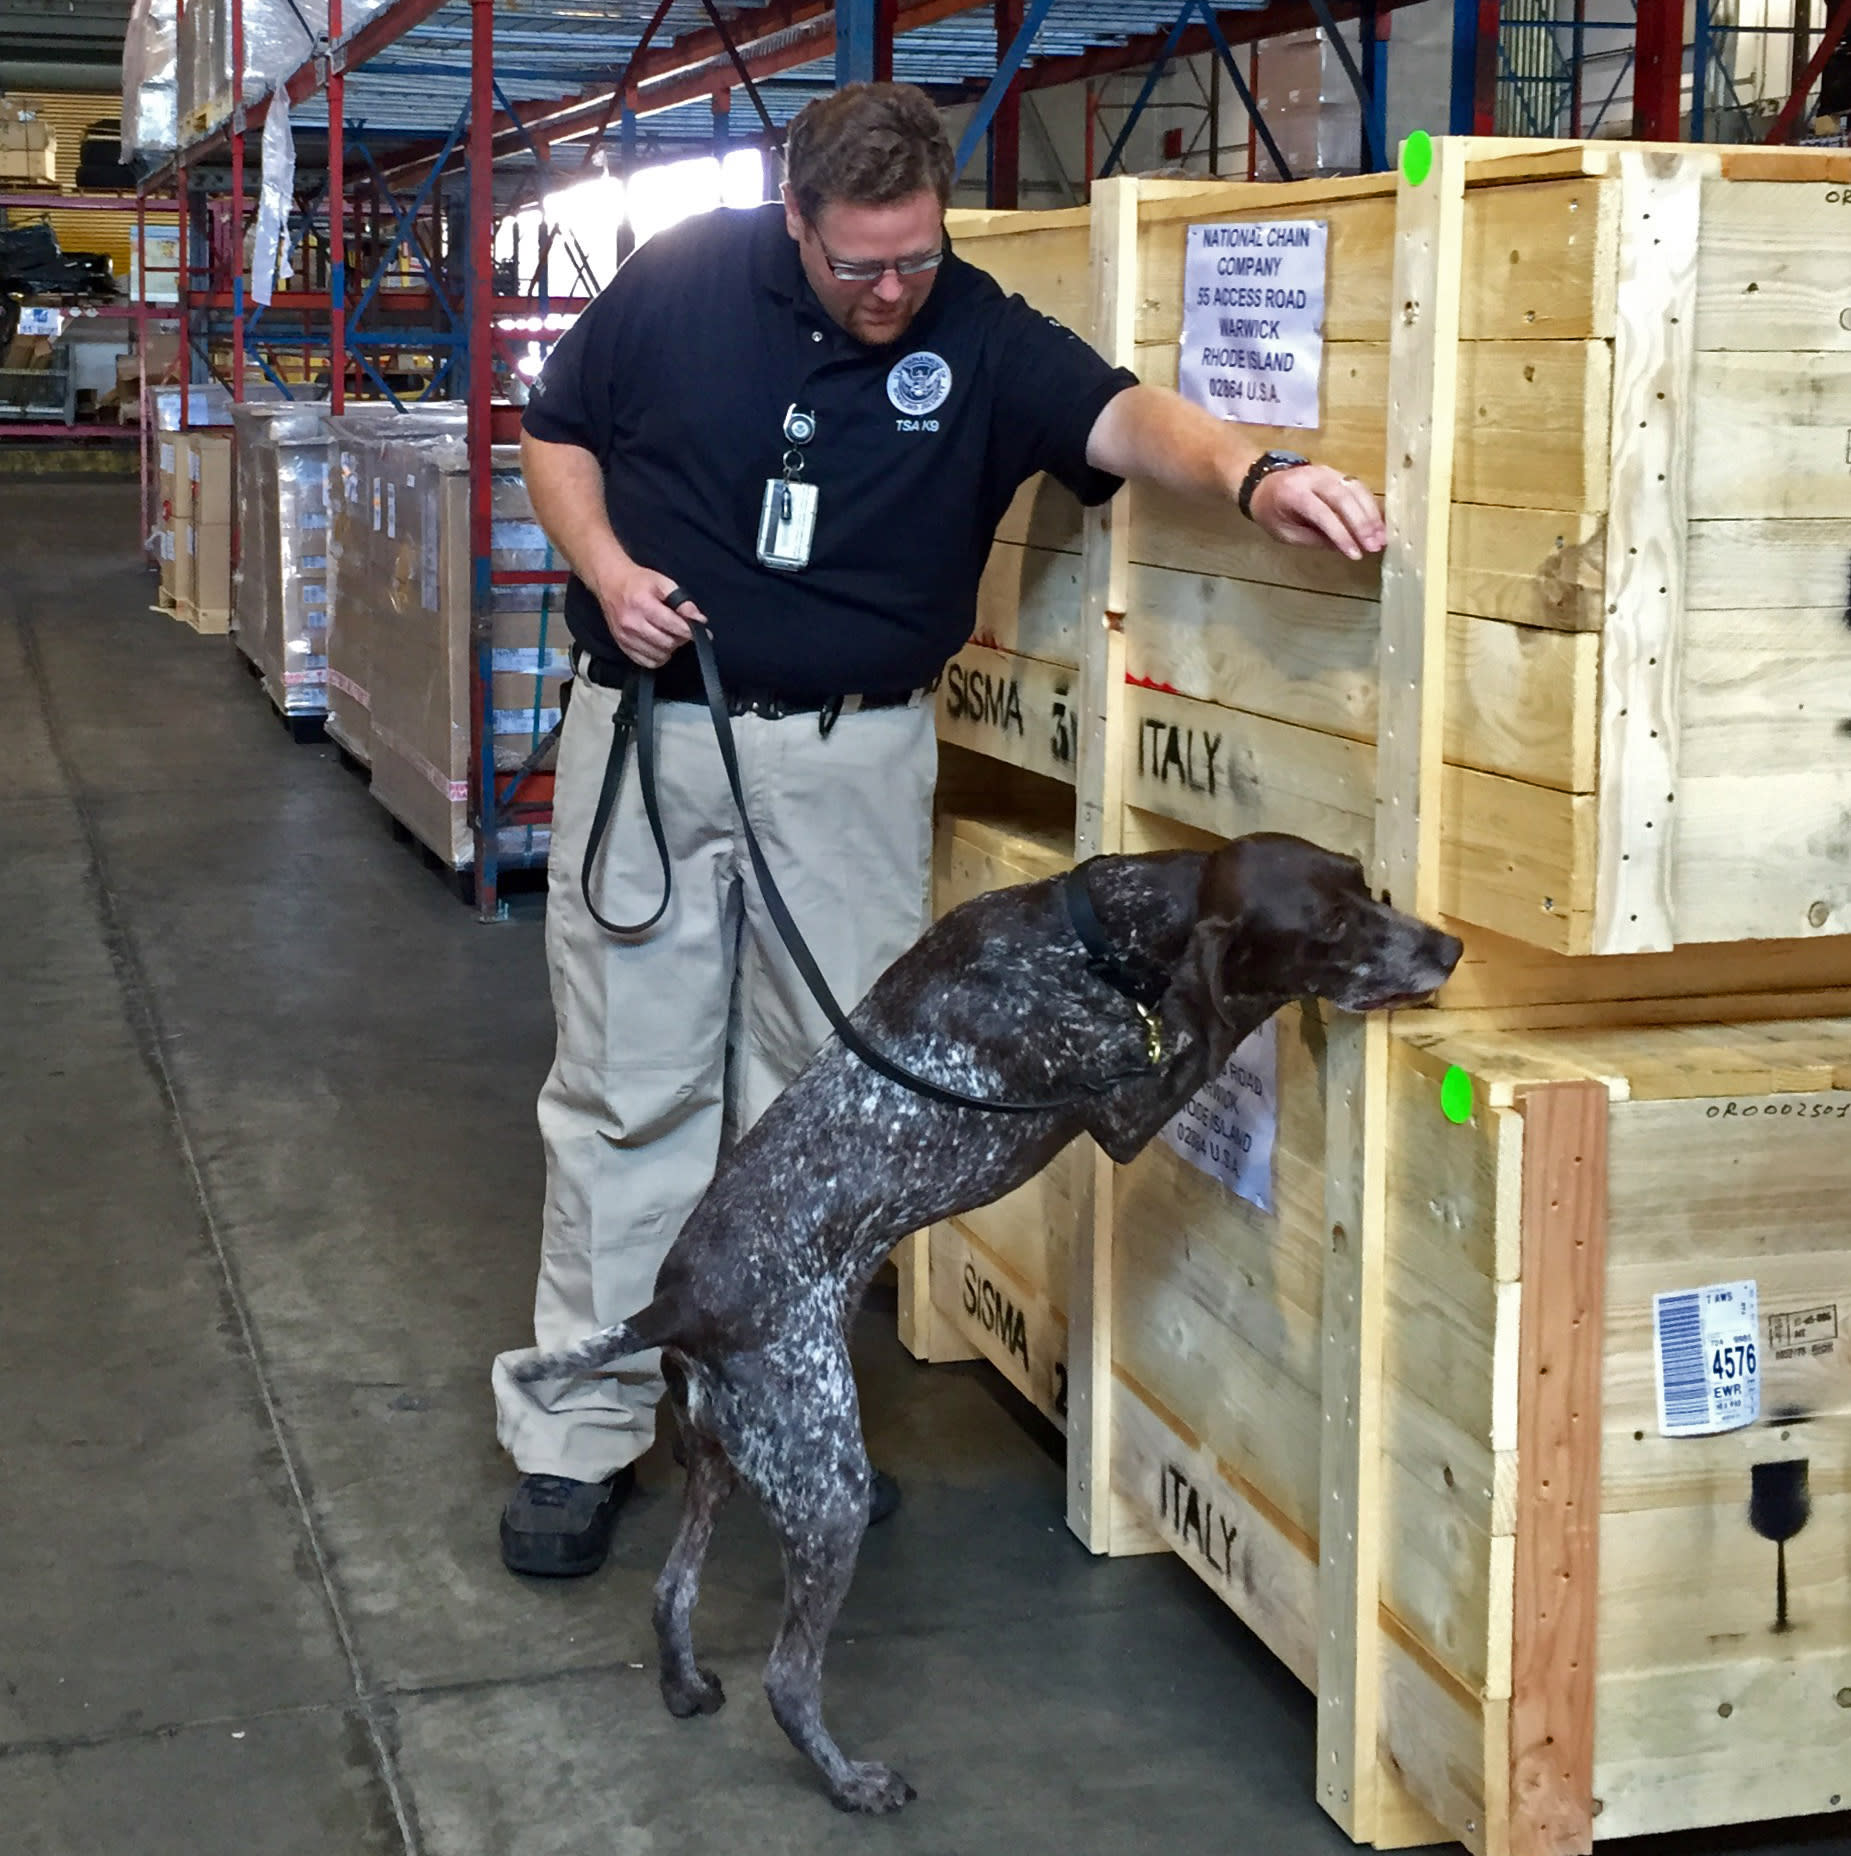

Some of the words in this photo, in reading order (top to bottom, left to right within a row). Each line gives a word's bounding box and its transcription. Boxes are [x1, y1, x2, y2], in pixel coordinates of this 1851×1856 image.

[1203, 228, 1264, 247] NATIONAL
[1267, 227, 1310, 247] CHAIN
[1216, 256, 1282, 276] COMPANY
[1197, 287, 1210, 306] 55
[1212, 288, 1262, 308] ACCESS
[1265, 289, 1306, 309] ROAD
[1219, 318, 1280, 339] WARWICK
[1202, 347, 1246, 369] RHODE
[1246, 352, 1294, 372] ISLAND
[1209, 378, 1243, 399] 02864
[896, 419, 919, 432] TSA
[921, 419, 940, 432] K9
[947, 664, 1024, 739] SISMA
[1138, 716, 1221, 796] ITALY
[1230, 1062, 1263, 1097] ROAD
[963, 1264, 1028, 1372] SISMA
[1713, 1343, 1757, 1380] 4576
[1714, 1383, 1742, 1399] EWR
[1161, 1462, 1237, 1584] ITALY
